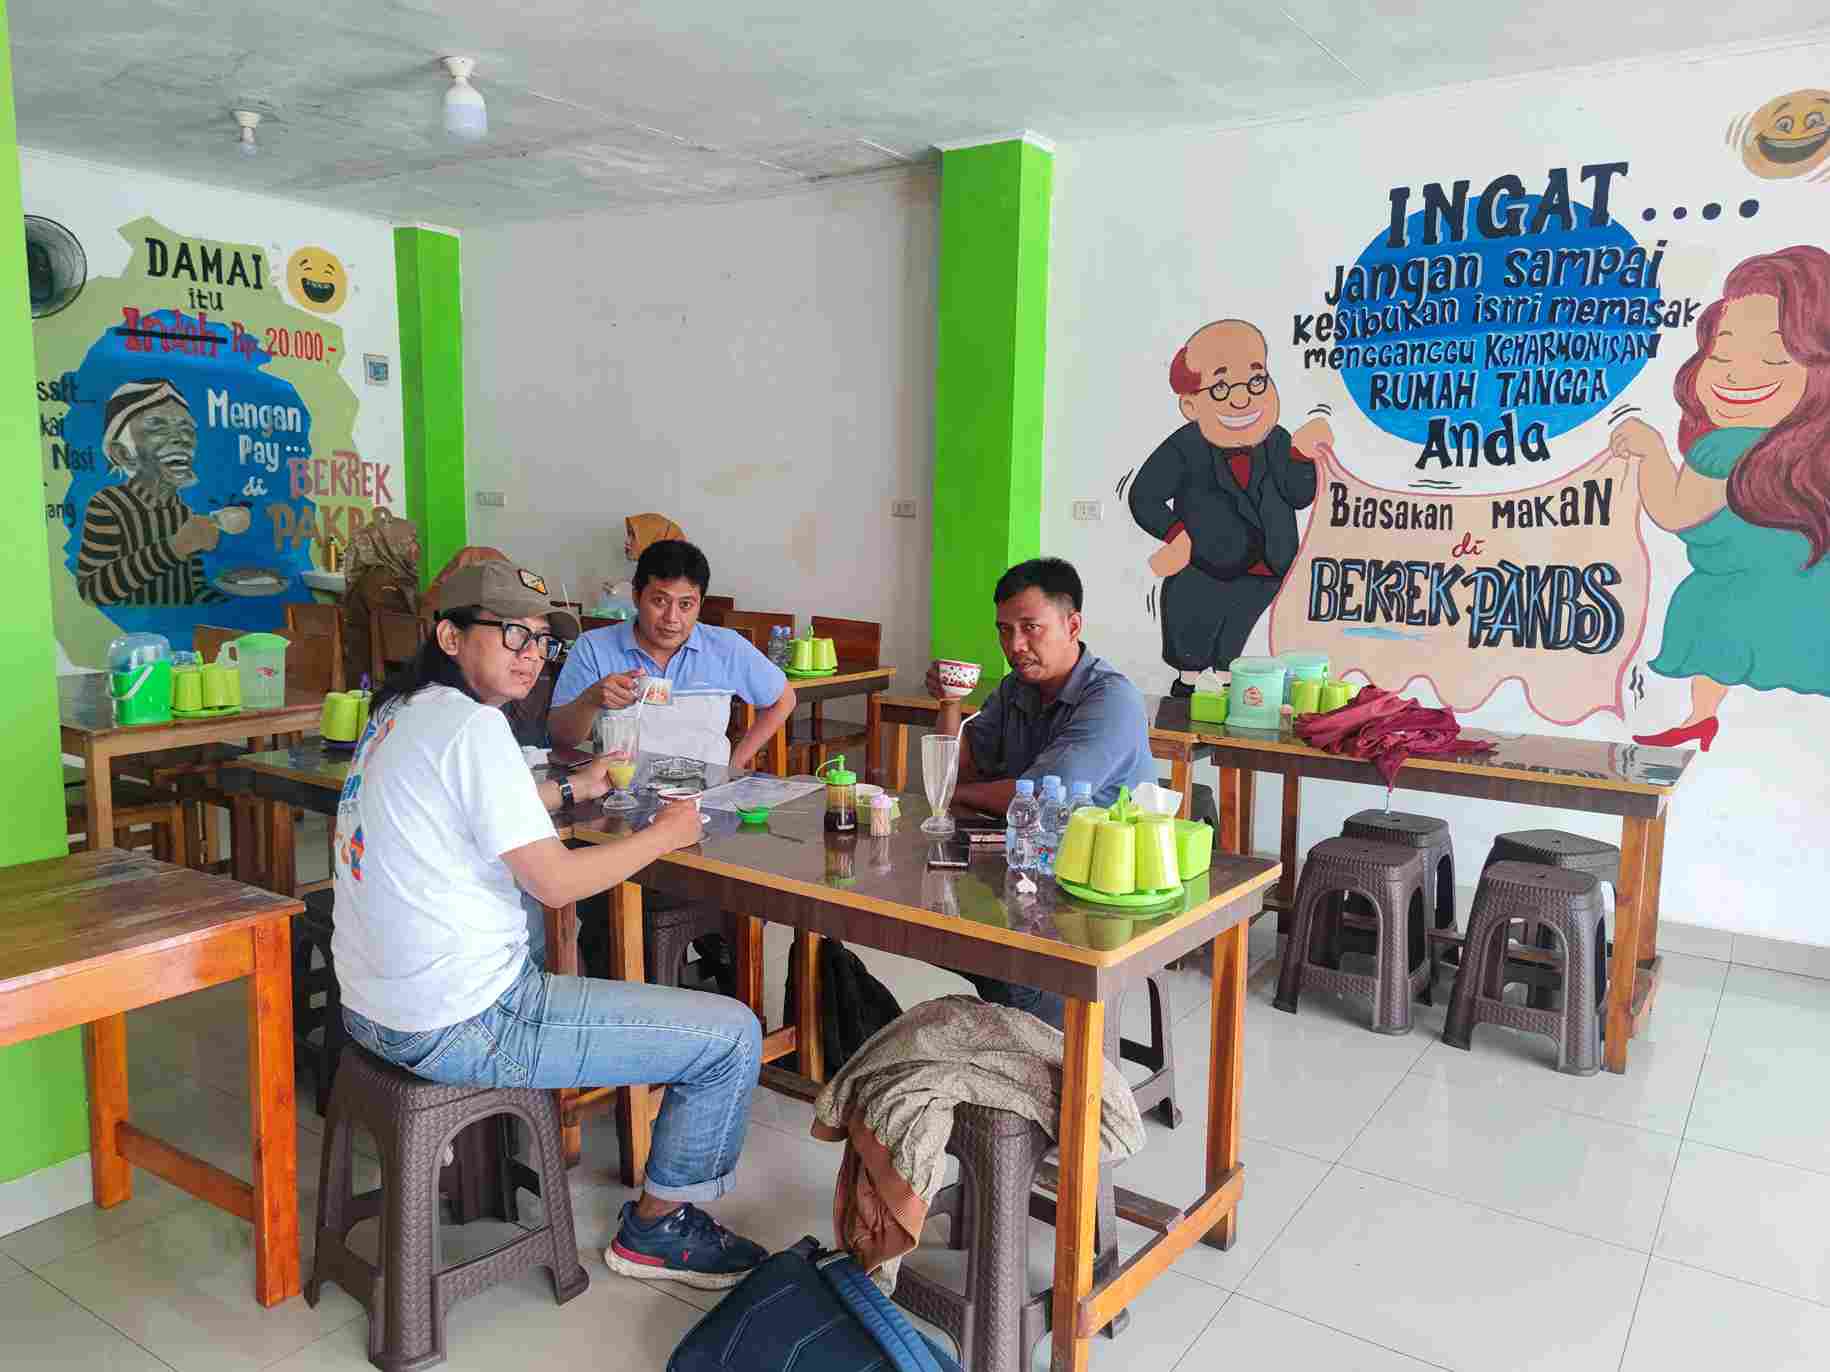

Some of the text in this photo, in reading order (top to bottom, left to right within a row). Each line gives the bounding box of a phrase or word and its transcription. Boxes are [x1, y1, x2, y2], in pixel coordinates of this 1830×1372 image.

[145, 237, 263, 289] DAMAI
[1503, 240, 1669, 290] sampai
[188, 287, 224, 311] itu
[1473, 291, 1544, 325] istri
[1550, 295, 1702, 330] memasak
[207, 387, 301, 438] Mengan
[1370, 369, 1608, 411] RUMAH TANGGA
[1415, 411, 1551, 469] Anda
[1451, 531, 1487, 559] di
